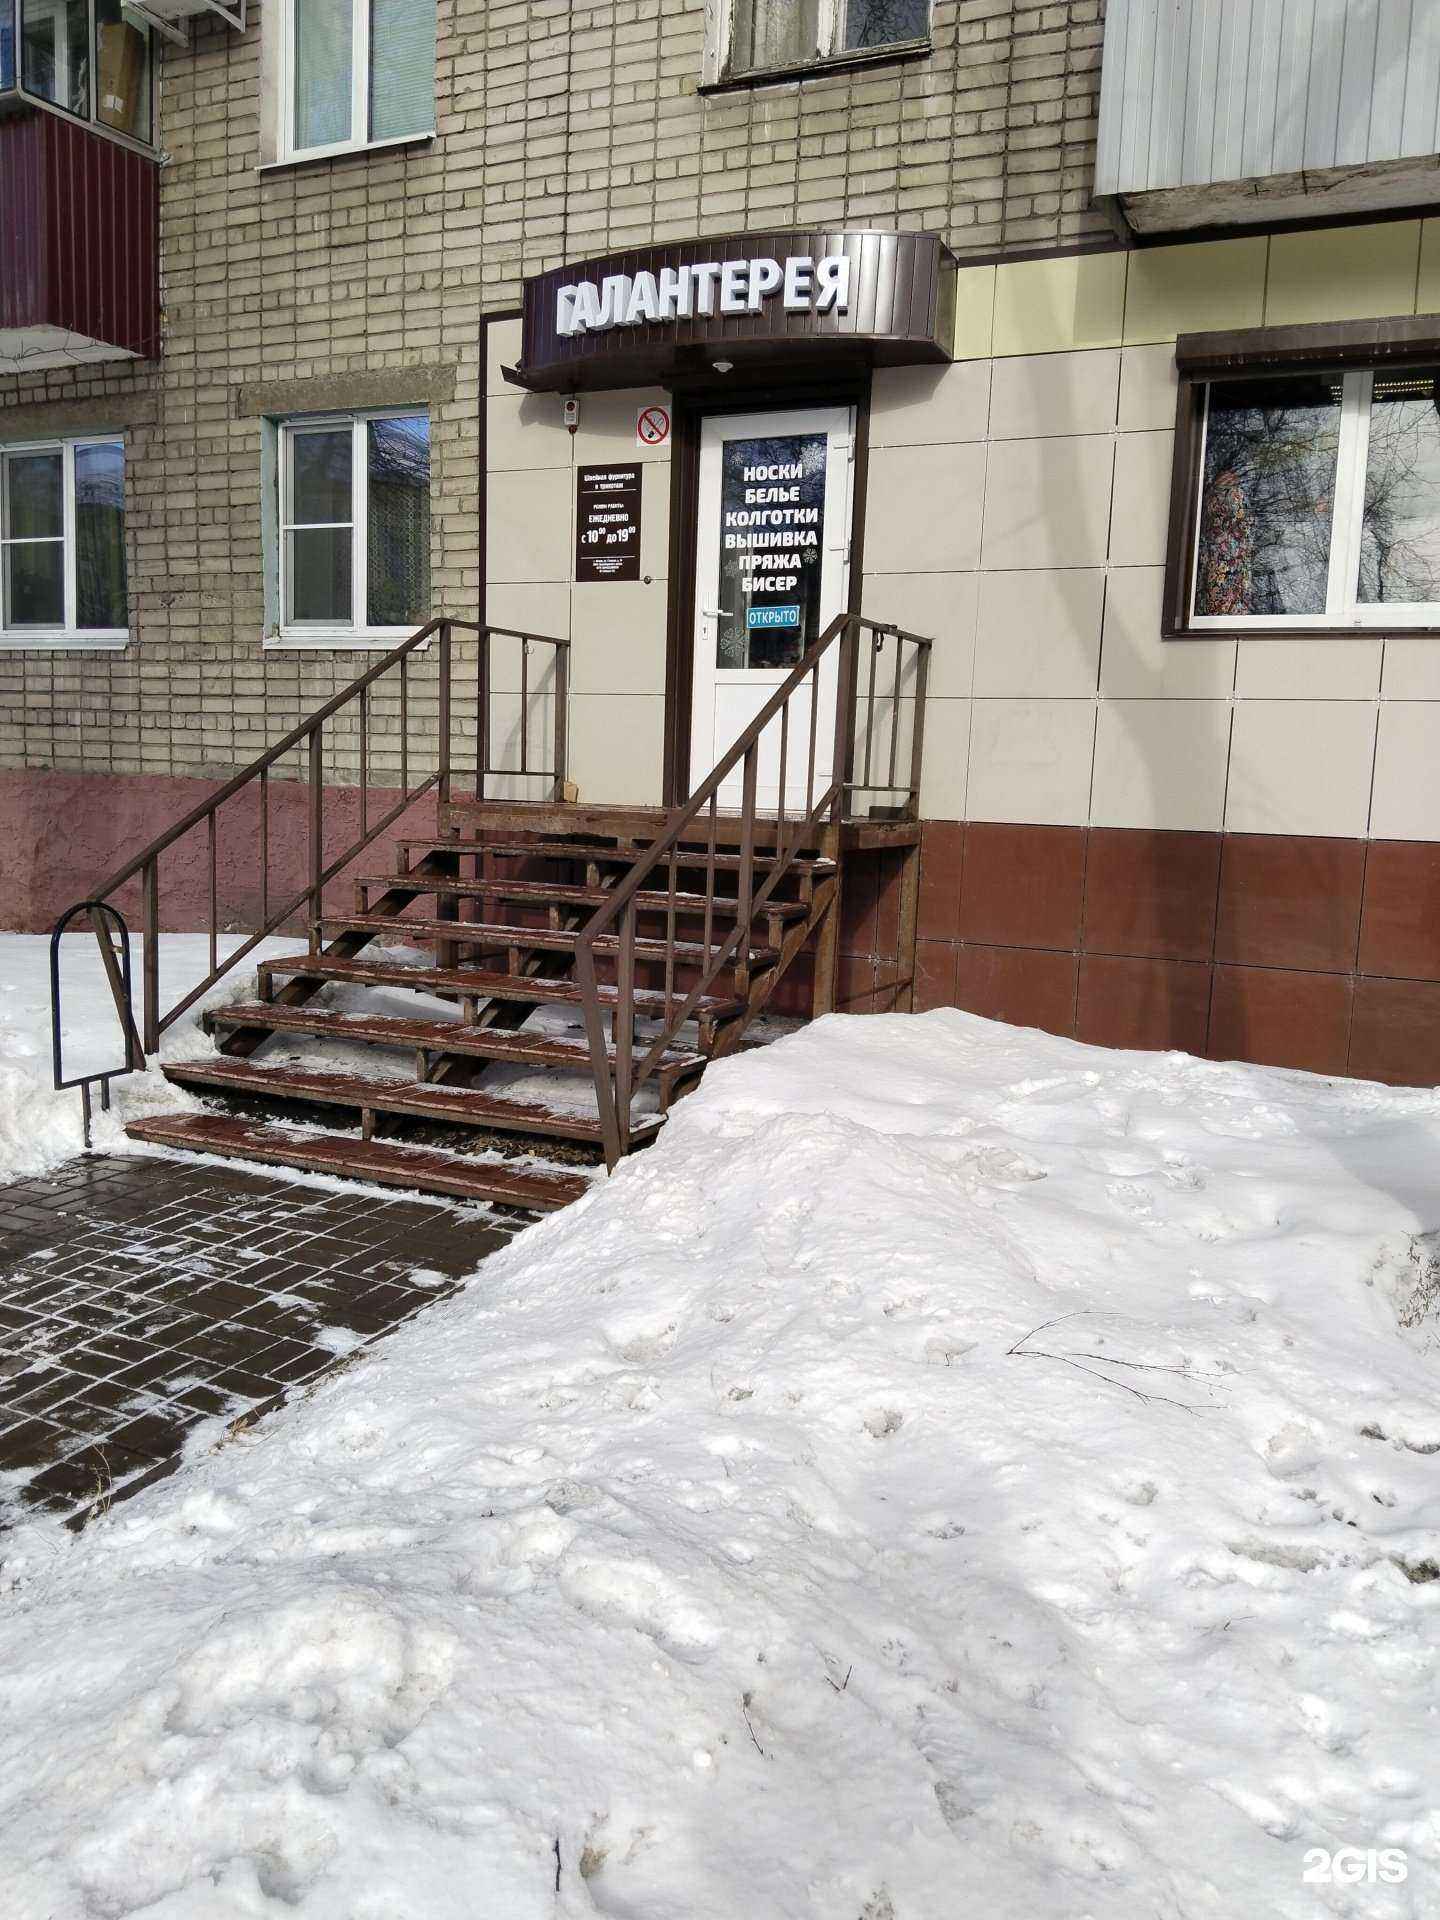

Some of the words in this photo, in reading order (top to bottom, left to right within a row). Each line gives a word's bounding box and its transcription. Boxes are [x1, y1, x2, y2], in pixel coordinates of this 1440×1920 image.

[556, 256, 850, 338] ГАЛАНТЕРЕЯ
[743, 464, 803, 482] НОСКИ
[745, 486, 800, 504] БЕЛЬЕ
[588, 513, 629, 523] ЕЖЕДНЕВНО
[725, 508, 818, 527] КОЛГОТКИ
[725, 530, 818, 549] ВЫШИВКА
[738, 554, 802, 570] ПРЯЖА
[742, 576, 798, 592] БИСЕР
[749, 609, 797, 625] ОТКРЫТО
